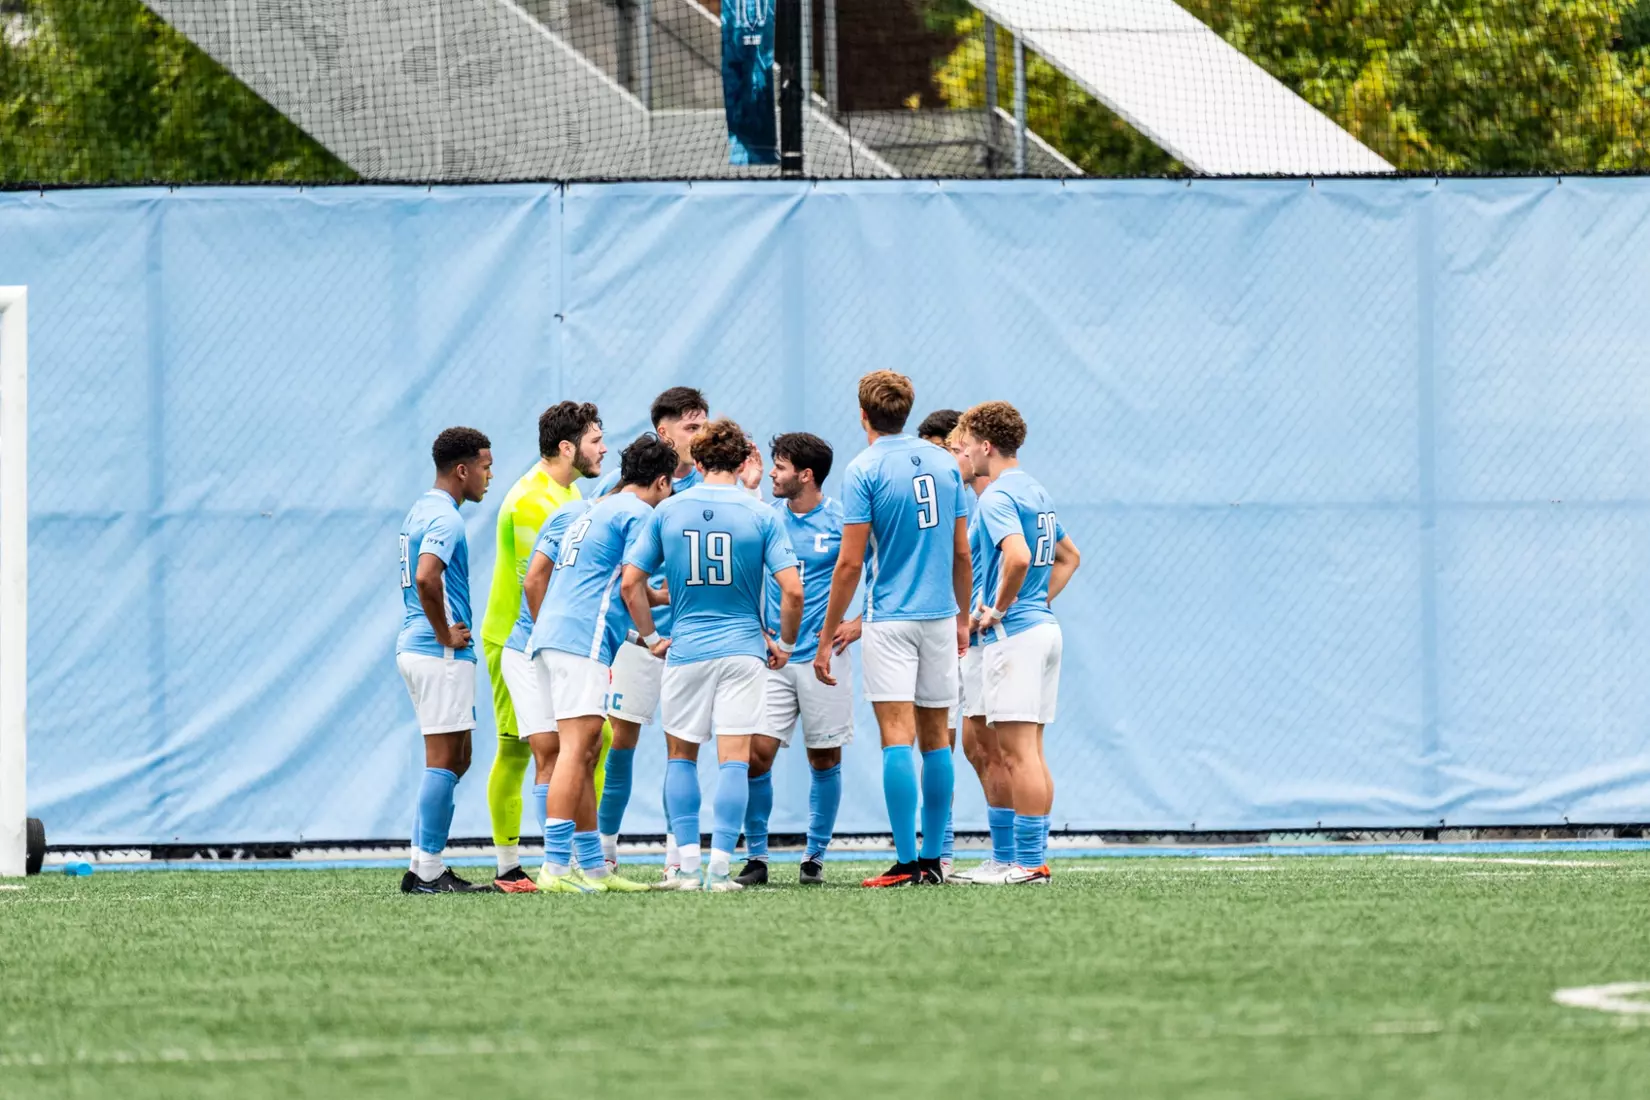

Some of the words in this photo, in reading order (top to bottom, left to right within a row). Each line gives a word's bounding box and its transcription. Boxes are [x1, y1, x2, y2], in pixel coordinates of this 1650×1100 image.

[912, 473, 939, 530] 9
[683, 530, 733, 586] 19
[814, 533, 830, 553] C
[1033, 511, 1057, 567] 20
[612, 692, 623, 710] C
